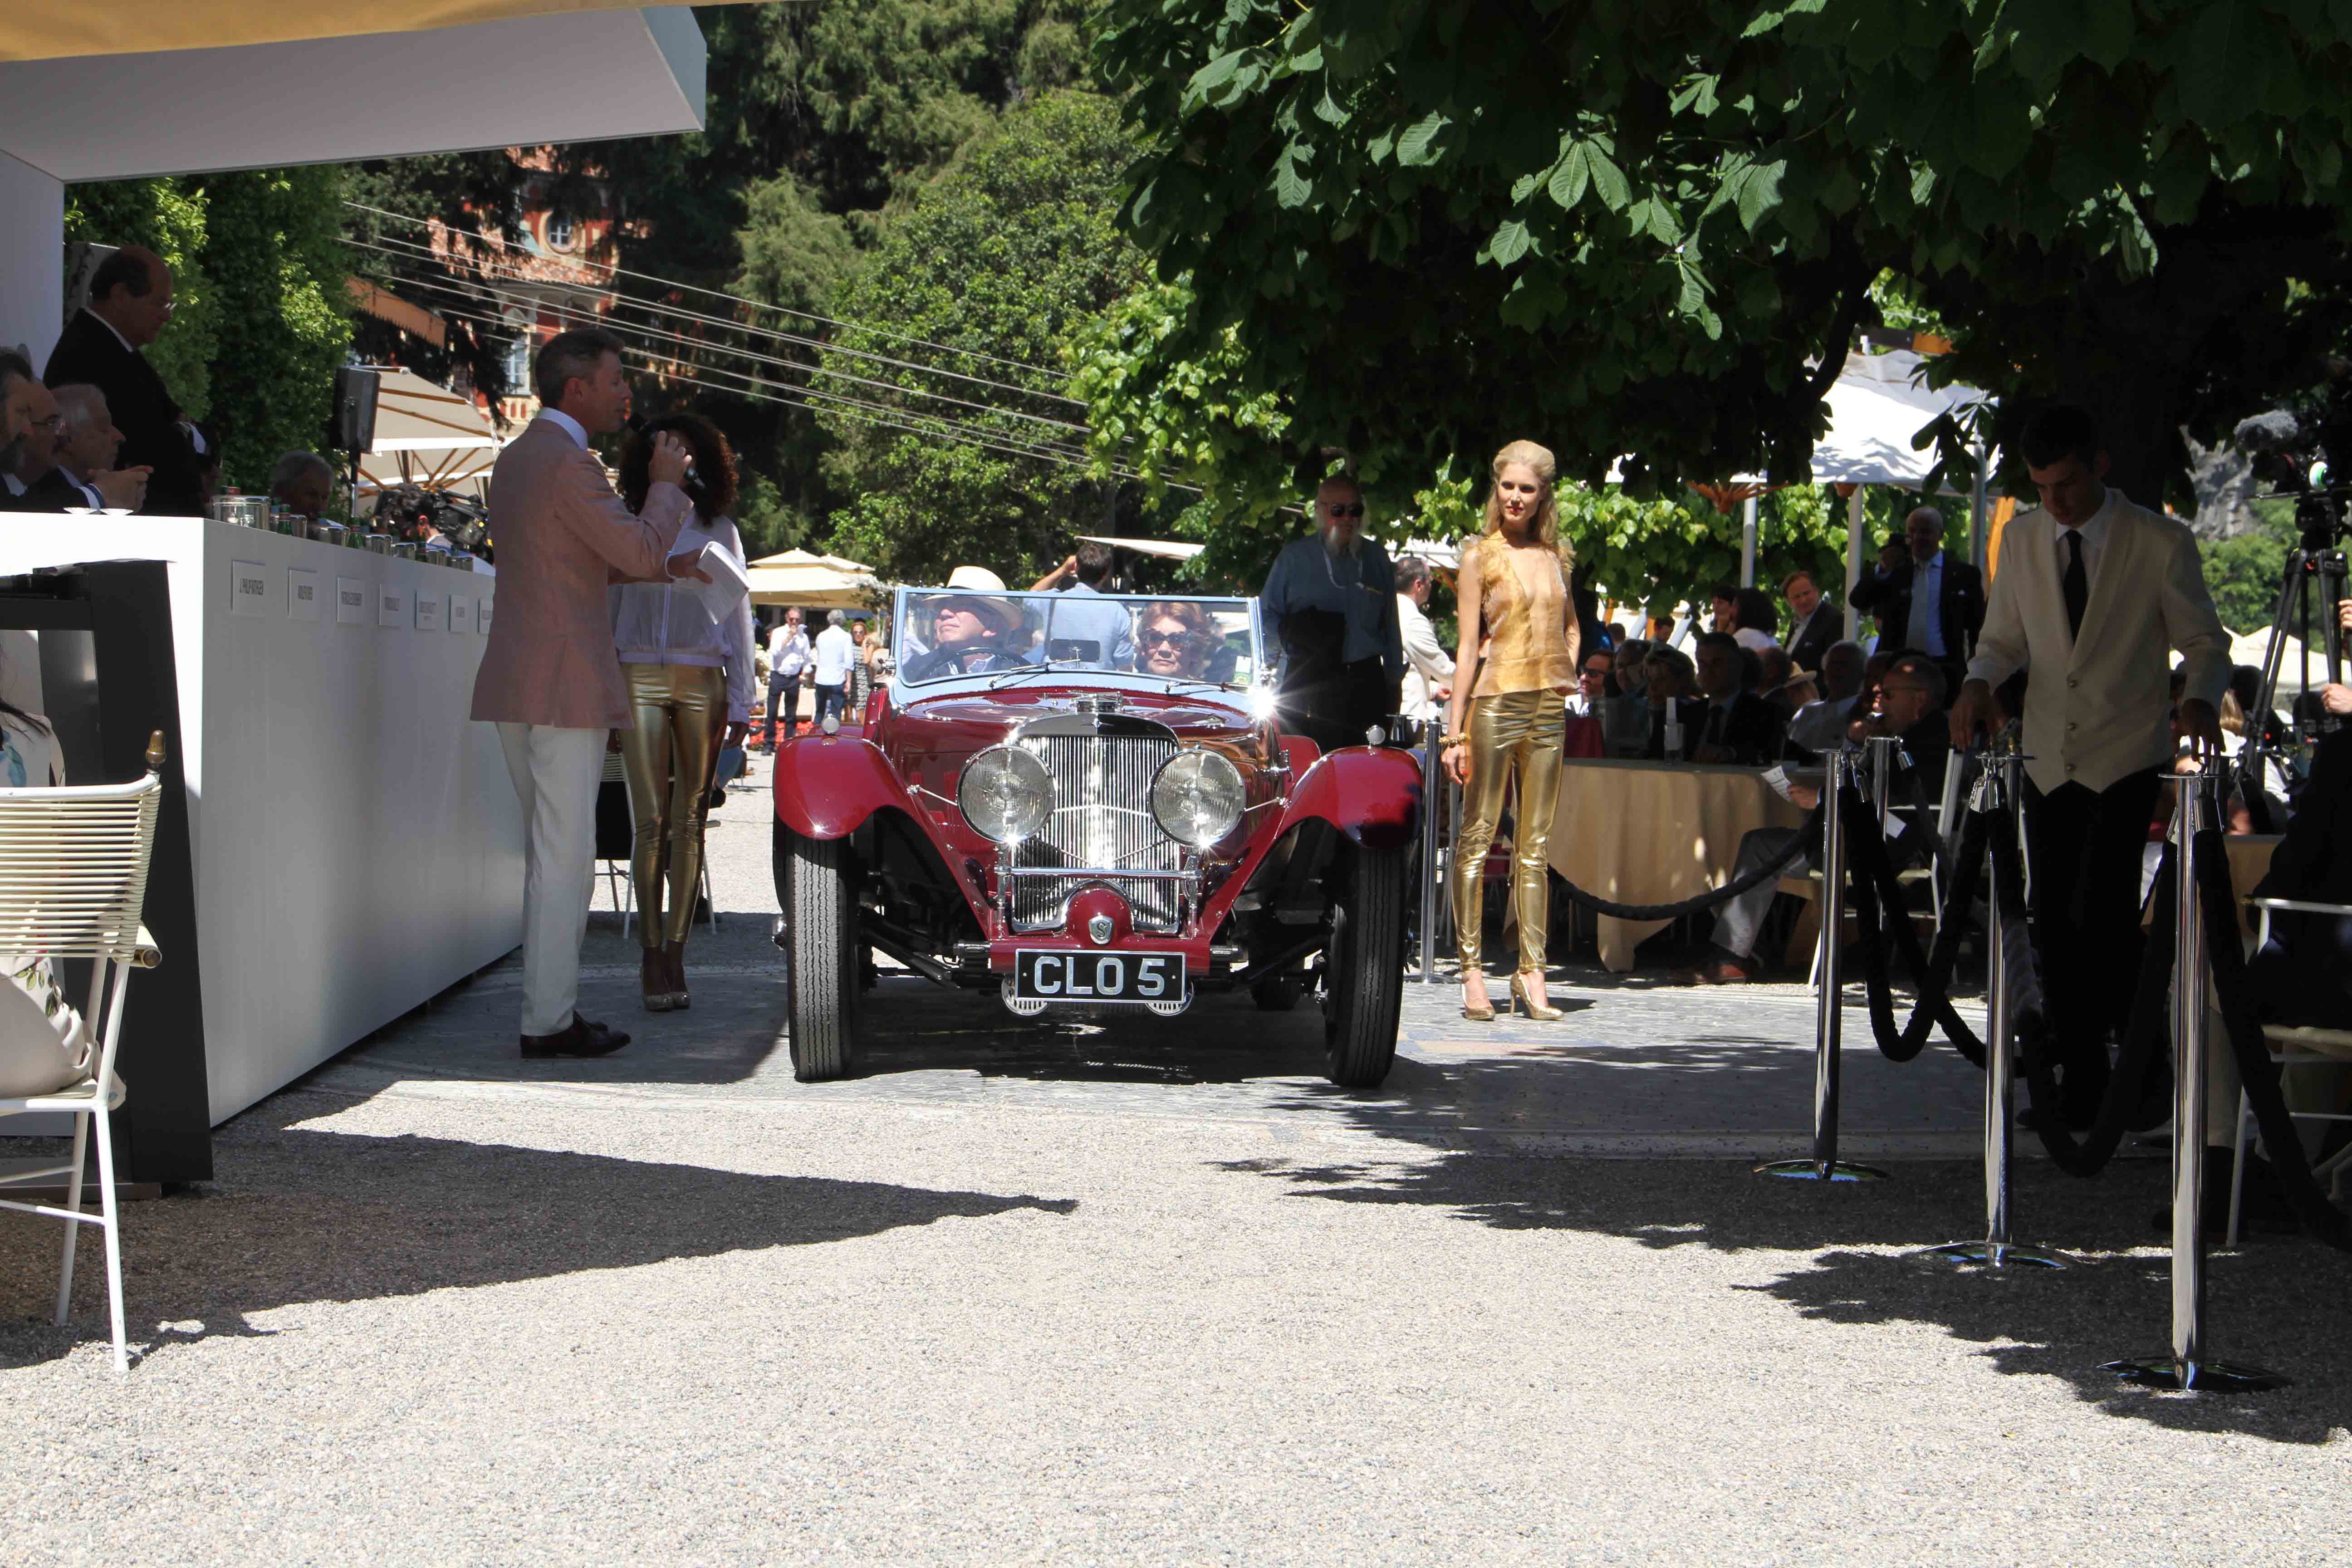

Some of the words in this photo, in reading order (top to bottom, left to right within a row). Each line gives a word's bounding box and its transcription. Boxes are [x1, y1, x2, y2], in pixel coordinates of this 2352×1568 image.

[1096, 922, 1107, 937] S
[1034, 956, 1124, 995] CLO
[1137, 958, 1165, 996] 5
